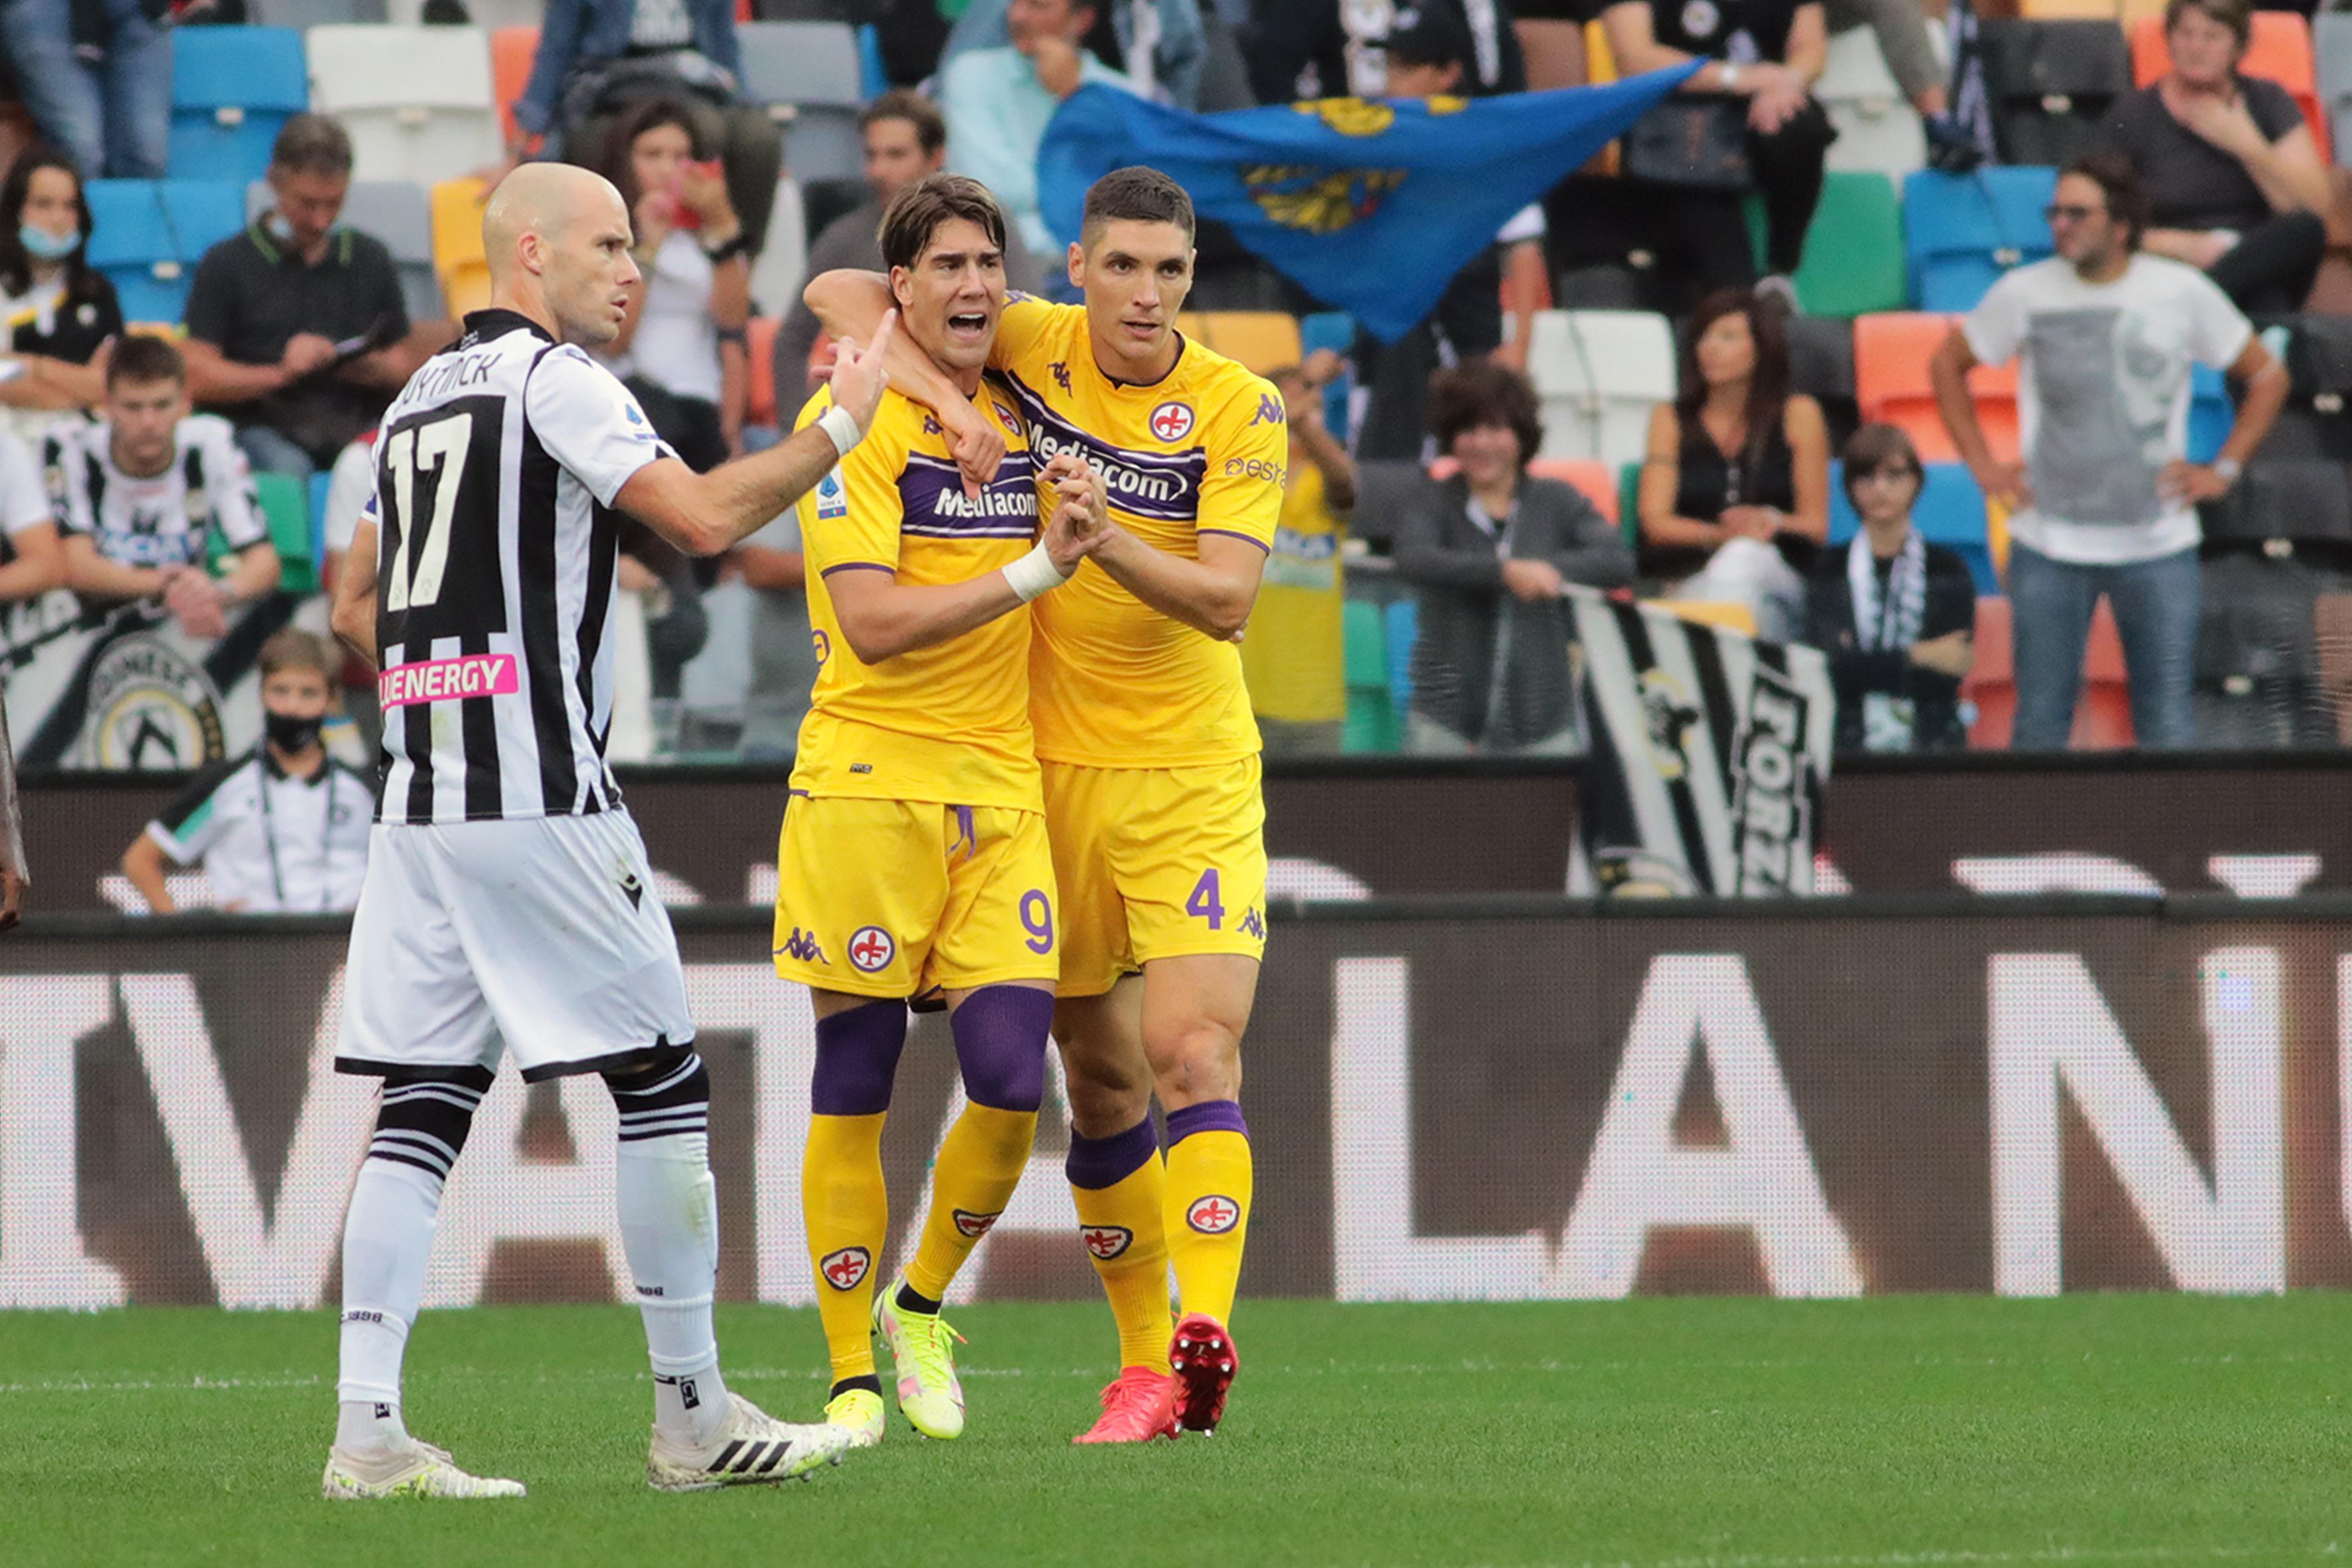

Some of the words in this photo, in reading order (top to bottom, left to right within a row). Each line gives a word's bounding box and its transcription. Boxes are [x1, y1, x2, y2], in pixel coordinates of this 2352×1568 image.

[394, 353, 503, 414] UYTINCK
[387, 413, 472, 611] 17
[1020, 889, 1053, 955] 9
[1186, 868, 1225, 929] 4
[1331, 953, 1865, 1302] LA
